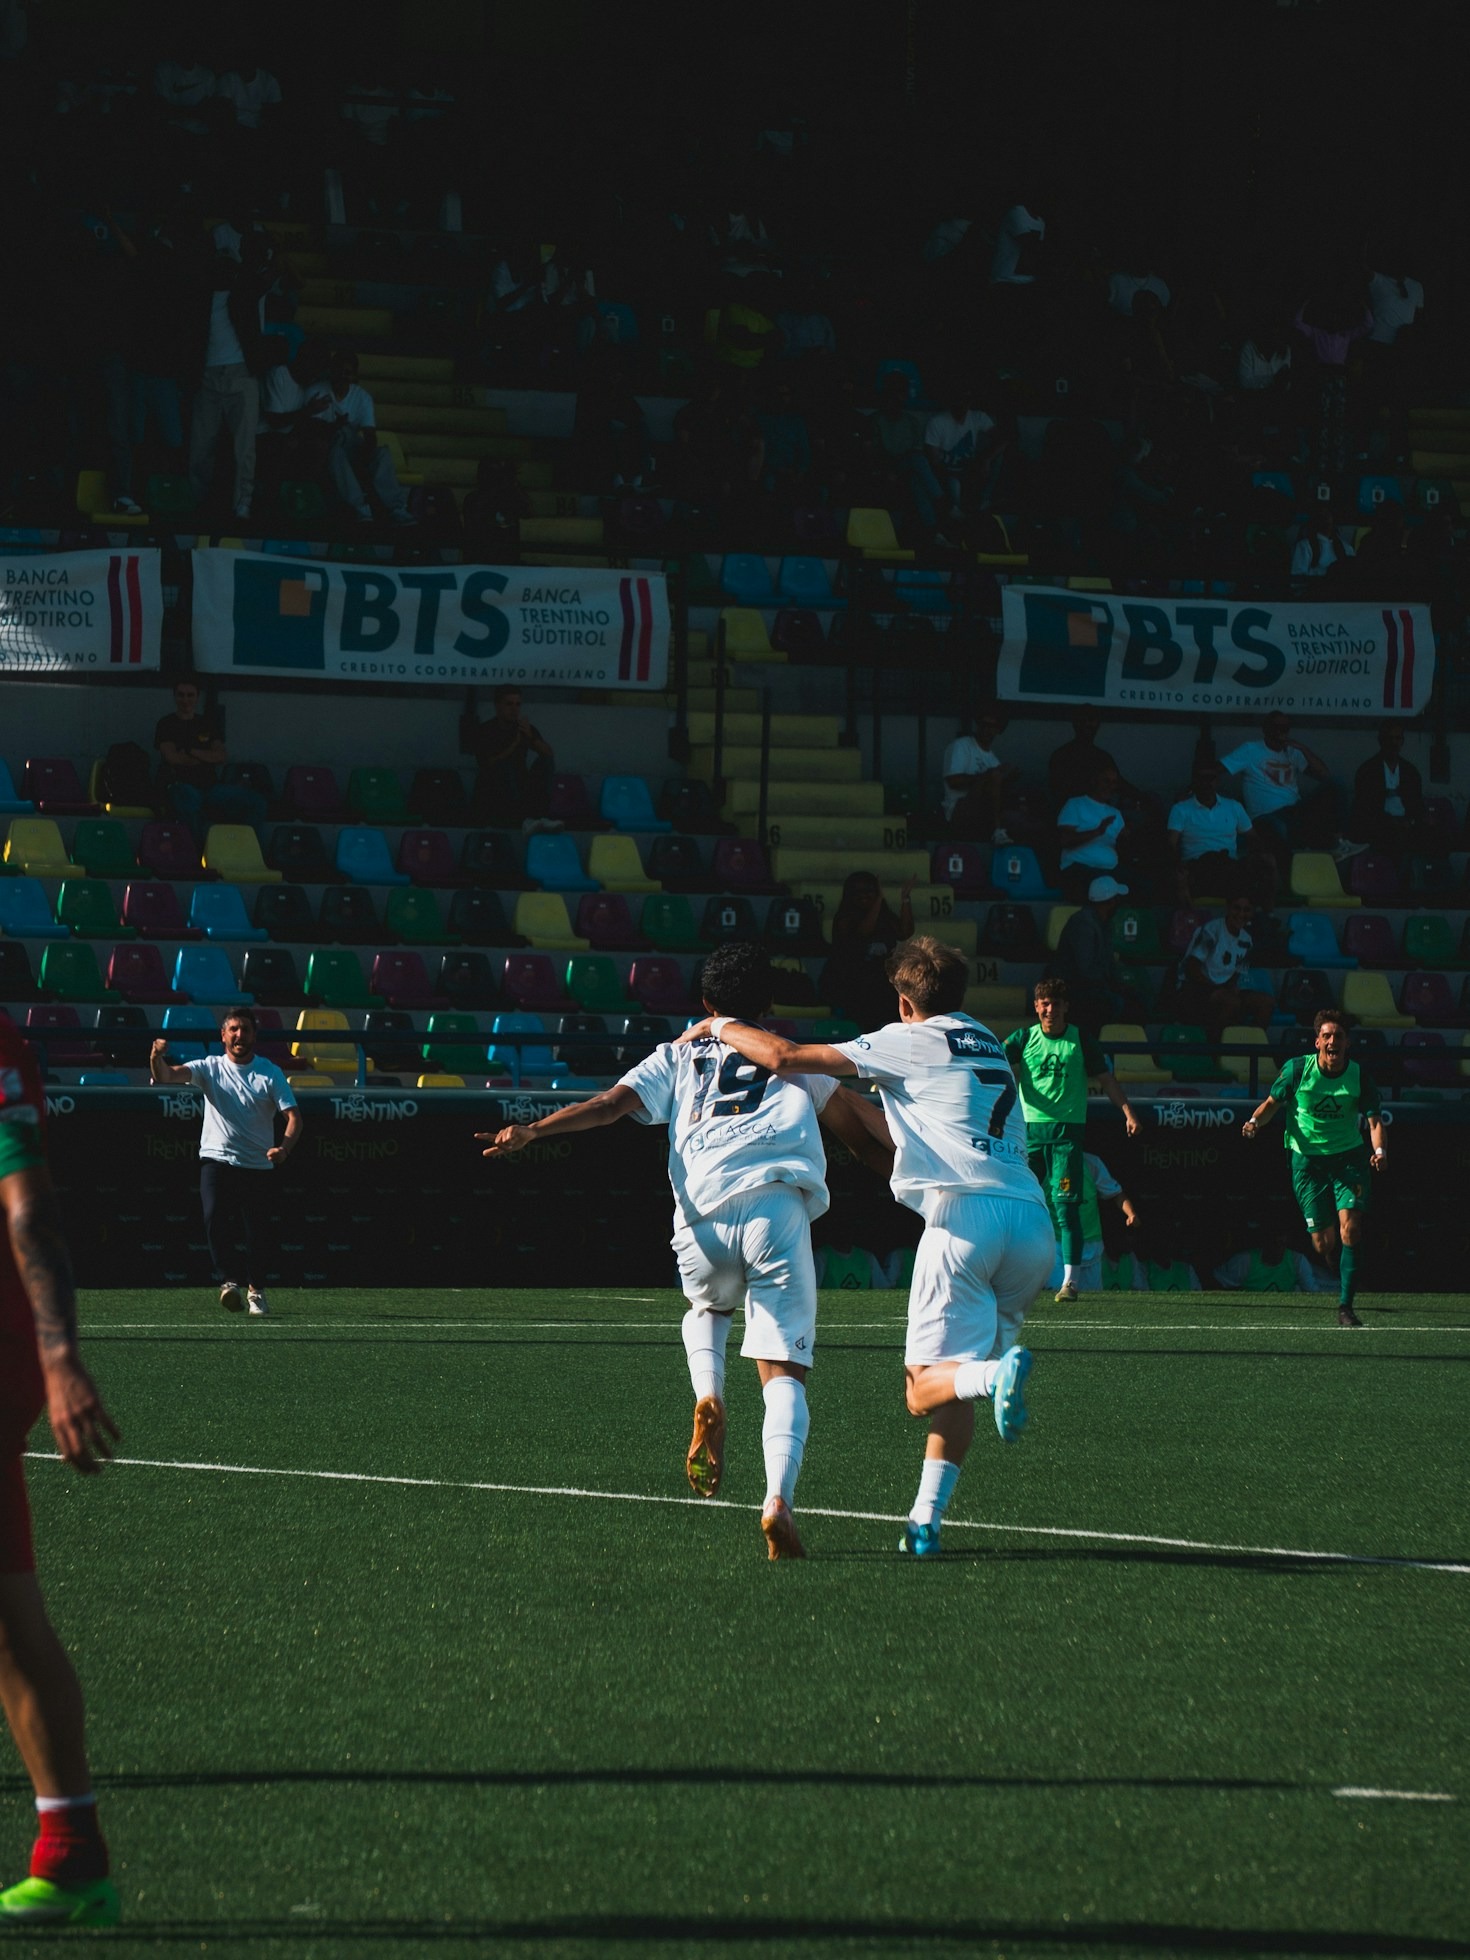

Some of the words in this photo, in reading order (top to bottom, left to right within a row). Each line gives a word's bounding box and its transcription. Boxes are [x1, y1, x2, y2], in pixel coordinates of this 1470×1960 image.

[6, 569, 68, 585] BANCA
[4, 590, 94, 606] TRENTINO
[522, 587, 581, 605] BANCA
[2, 606, 93, 627] SÜDTIROL
[339, 570, 510, 658] BTS
[520, 608, 610, 625] TRENTINO
[522, 624, 606, 646] SÜDTIROL
[1288, 623, 1349, 638] BANCA
[1121, 603, 1286, 688] BTS
[1291, 639, 1375, 655] TRENTINO
[16, 651, 97, 663] ITALIANO
[1296, 655, 1370, 675] SÜDTIROL
[340, 661, 407, 674] CREDITO
[415, 664, 526, 679] COOPERATIVO
[534, 669, 606, 680] ITALIANO
[1120, 690, 1184, 703] CREDITO
[1192, 694, 1295, 706] COOPERATIVO
[1302, 697, 1372, 708] ITALIANO
[930, 896, 952, 917] D5
[977, 961, 999, 984] D4
[688, 1052, 771, 1127] 19
[158, 1095, 203, 1121] TREN
[330, 1097, 418, 1123] TRENTINO
[971, 1068, 1017, 1140] 7
[1153, 1104, 1235, 1130] TRENTINO
